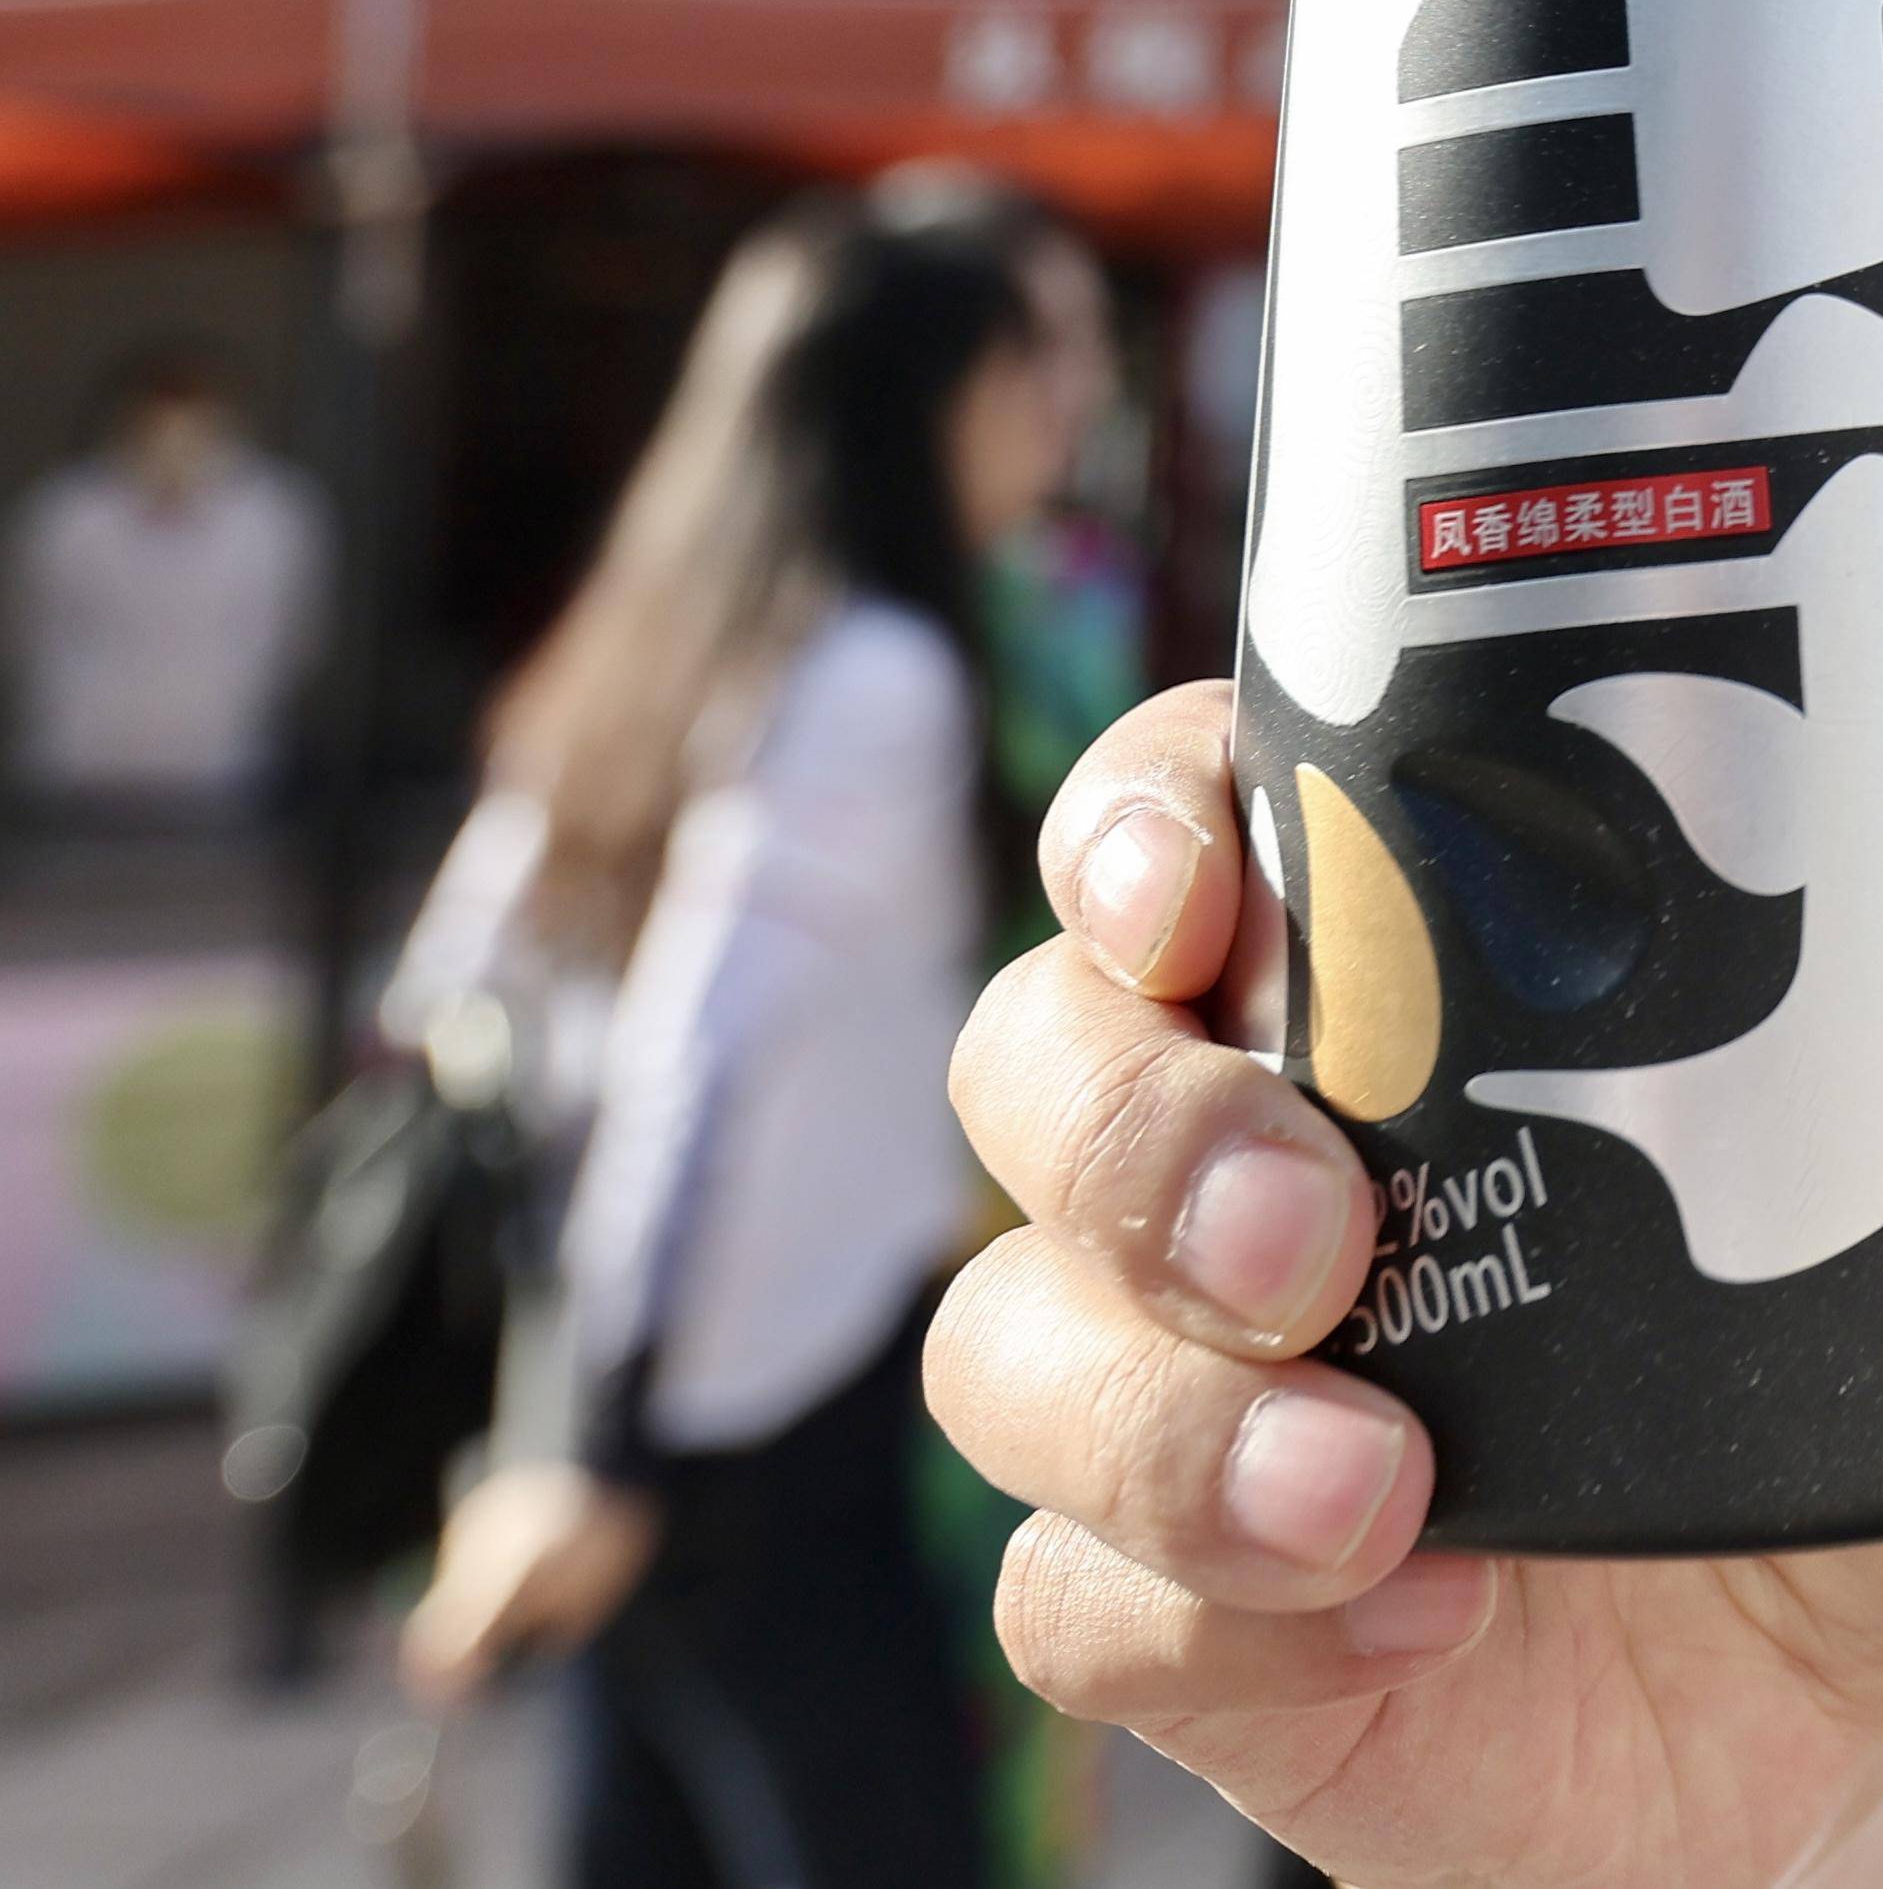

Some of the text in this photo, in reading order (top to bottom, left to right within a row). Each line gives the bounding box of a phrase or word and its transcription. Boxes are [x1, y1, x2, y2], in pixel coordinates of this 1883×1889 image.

[1430, 477, 1756, 560] 凤香绵柔型白酒
